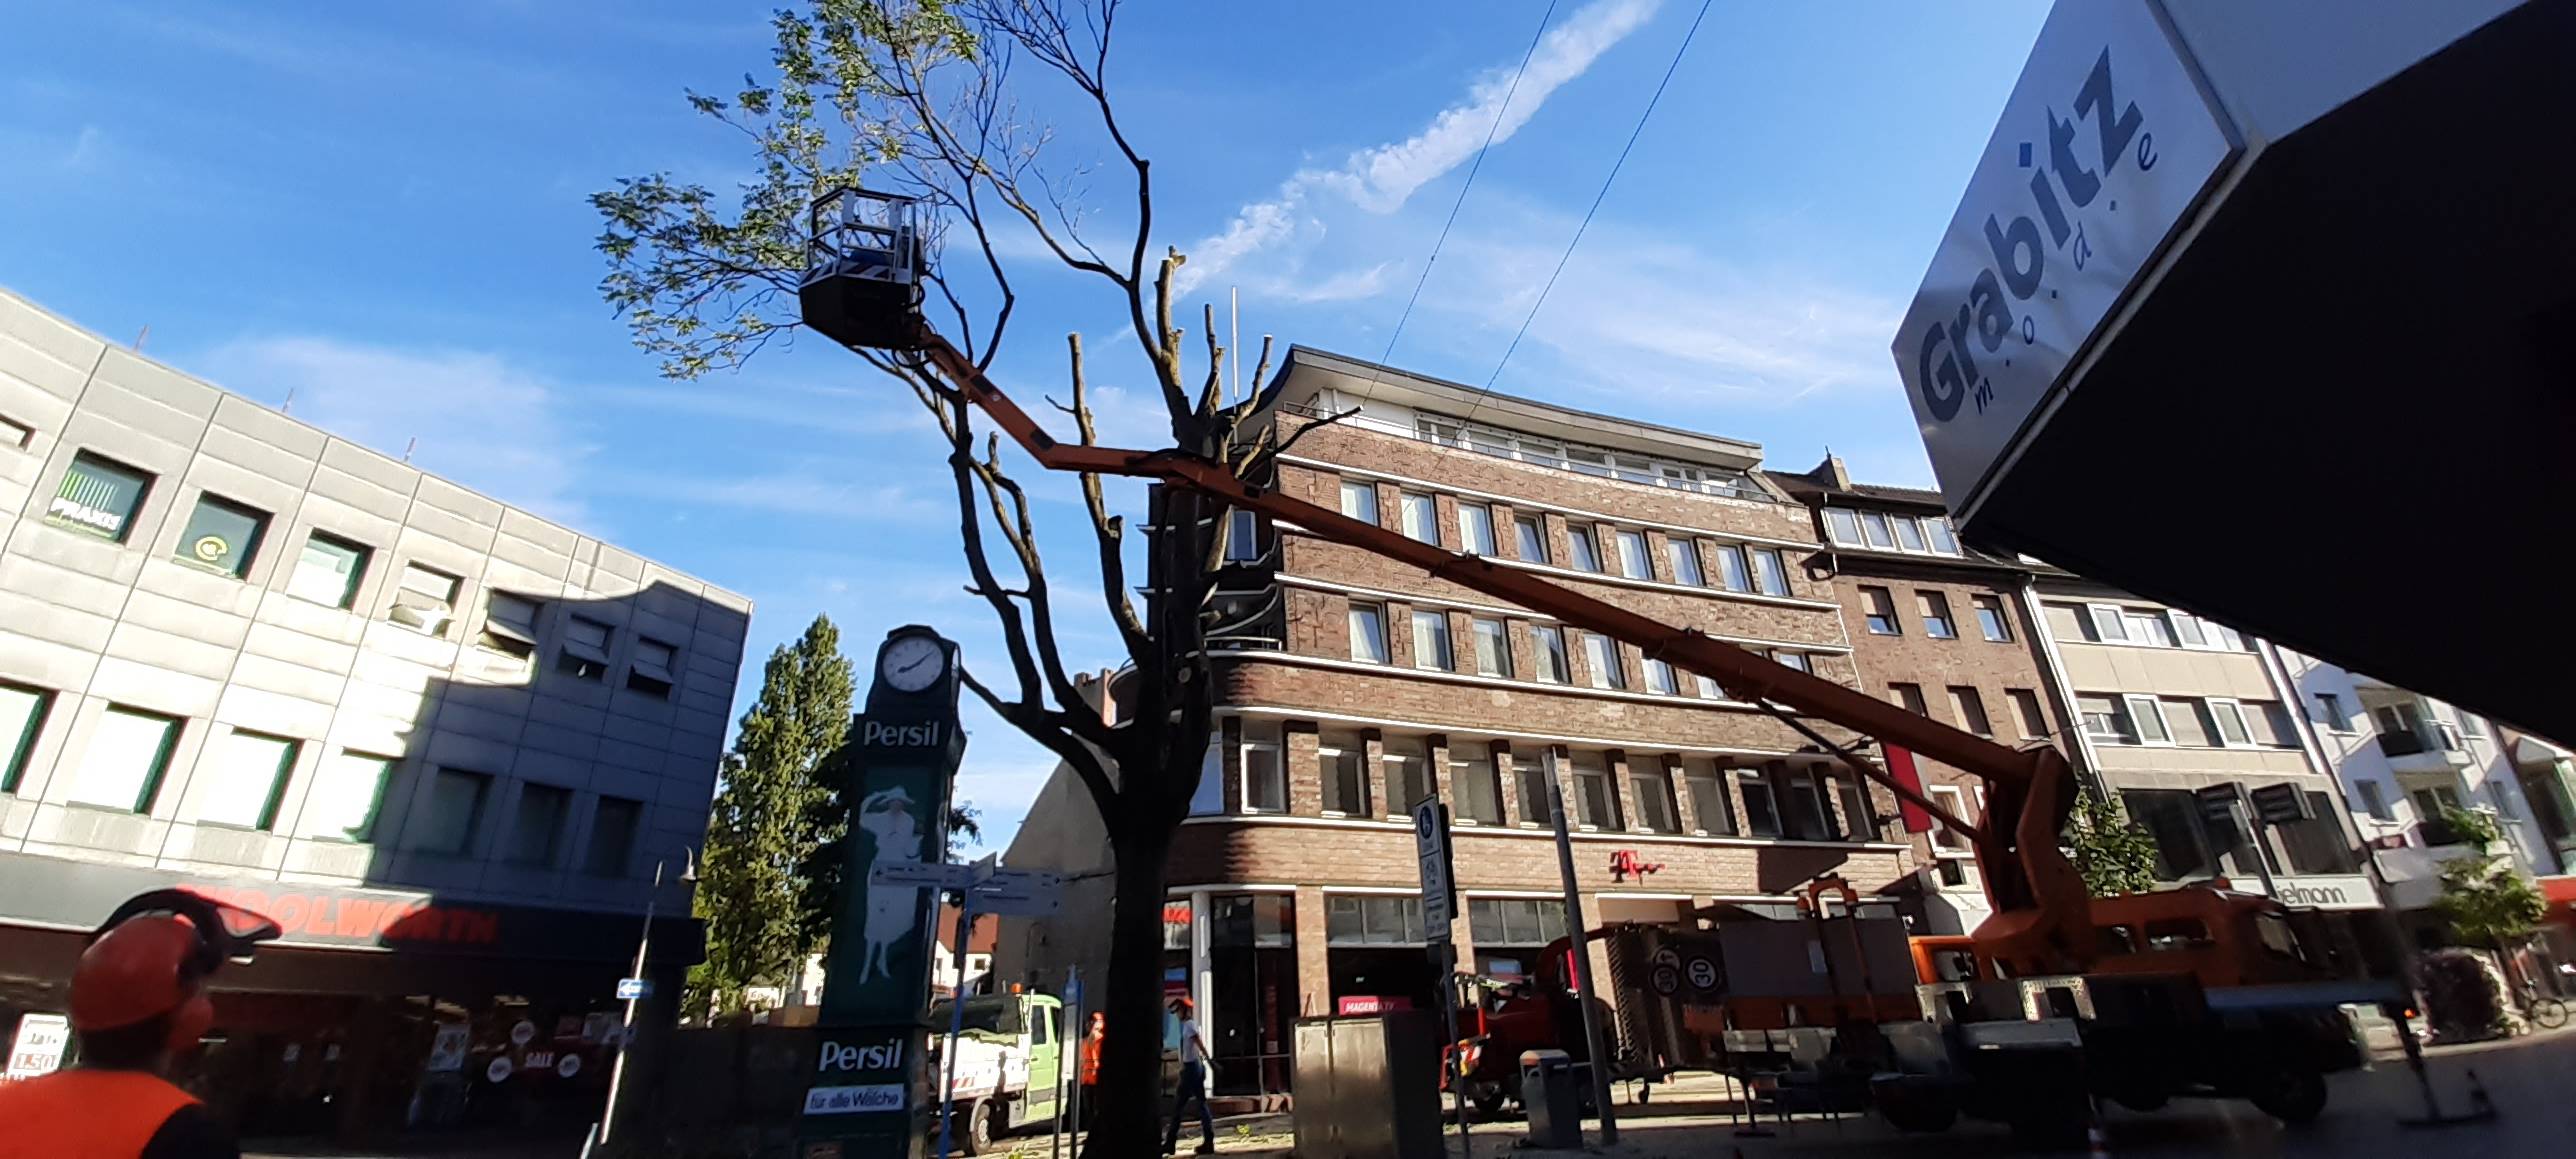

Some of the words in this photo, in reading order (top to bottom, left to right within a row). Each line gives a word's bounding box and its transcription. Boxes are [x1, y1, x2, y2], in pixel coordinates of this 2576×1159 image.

[1919, 44, 2144, 423] Grabitz
[50, 496, 121, 531] PRAXIS
[863, 720, 939, 746] Persil
[177, 884, 498, 942] OOLWORTH
[525, 1051, 555, 1068] SALE
[819, 1039, 903, 1071] Persil
